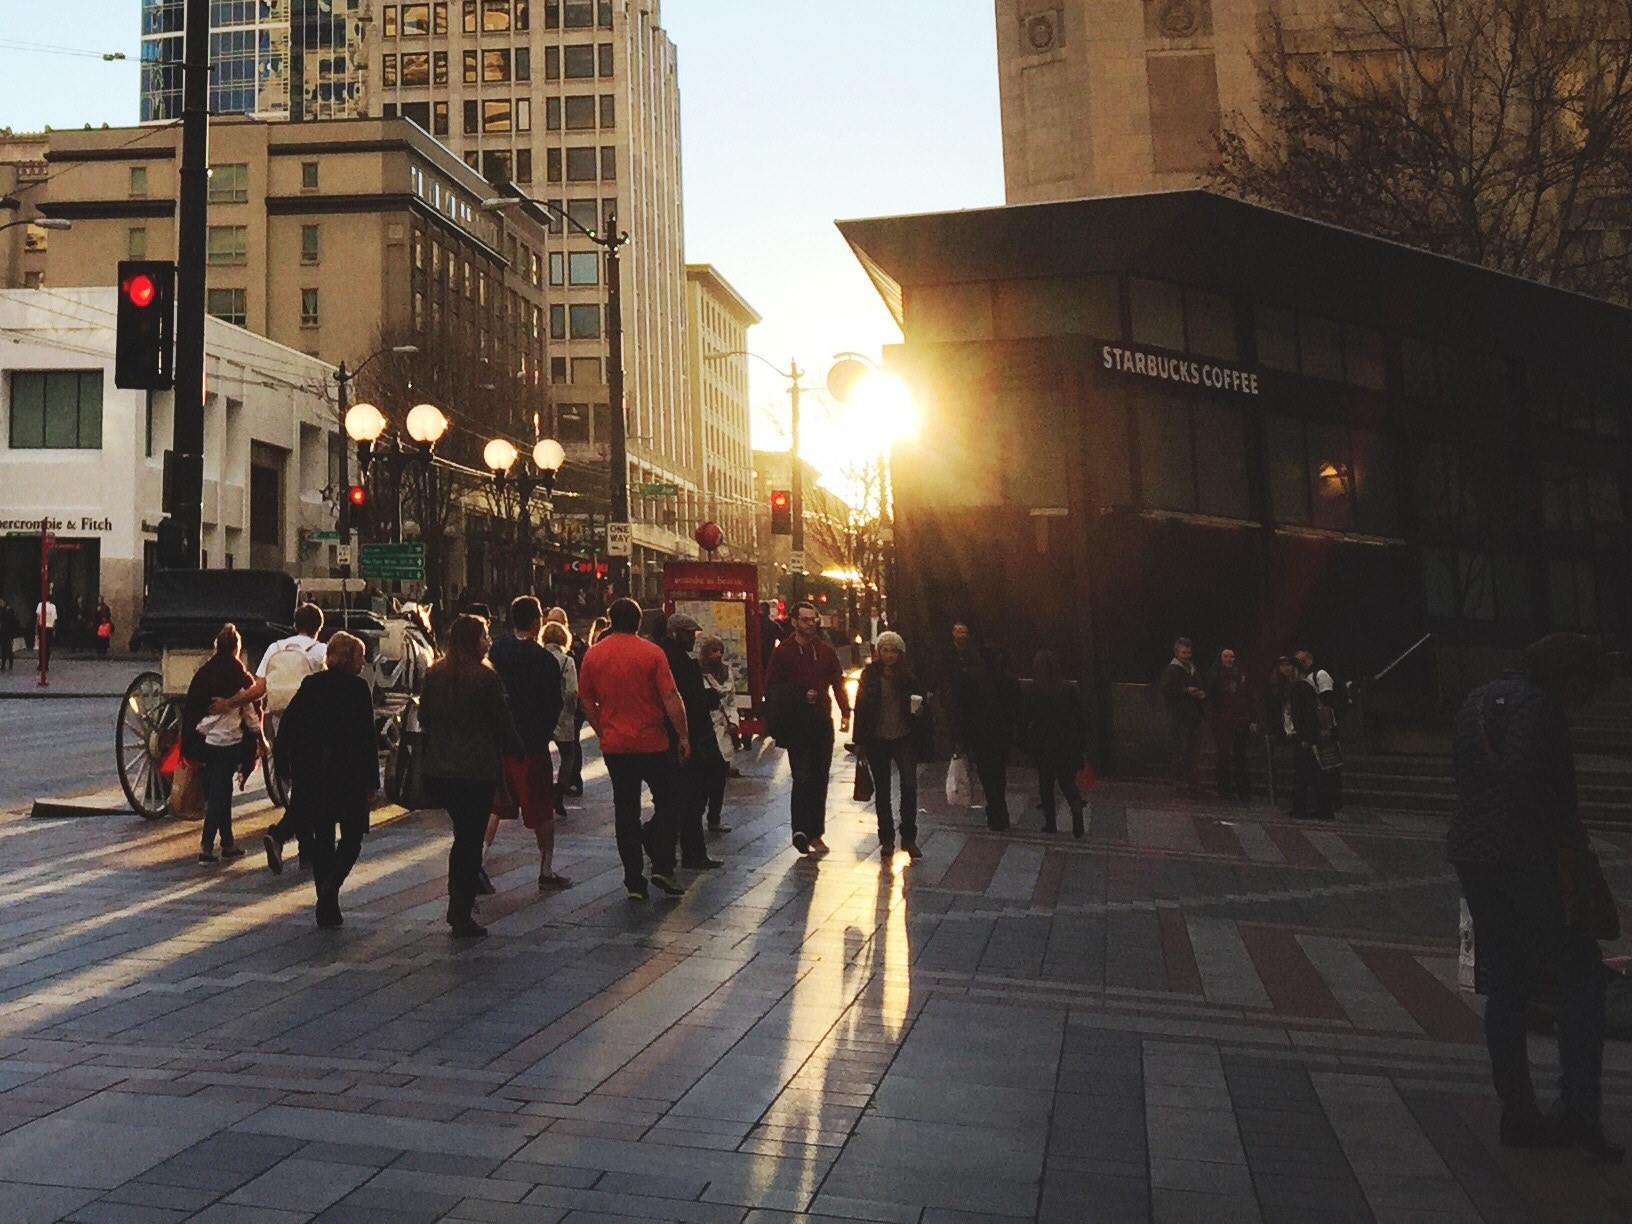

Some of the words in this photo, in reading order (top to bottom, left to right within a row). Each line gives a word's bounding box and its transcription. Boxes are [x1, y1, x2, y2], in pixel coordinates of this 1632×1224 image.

[1102, 345, 1200, 385] STARBUCKS
[1202, 364, 1259, 395] COFFEE
[66, 520, 77, 531] &
[81, 516, 113, 531] Fitch
[609, 525, 630, 534] ONE
[610, 534, 630, 543] WAY
